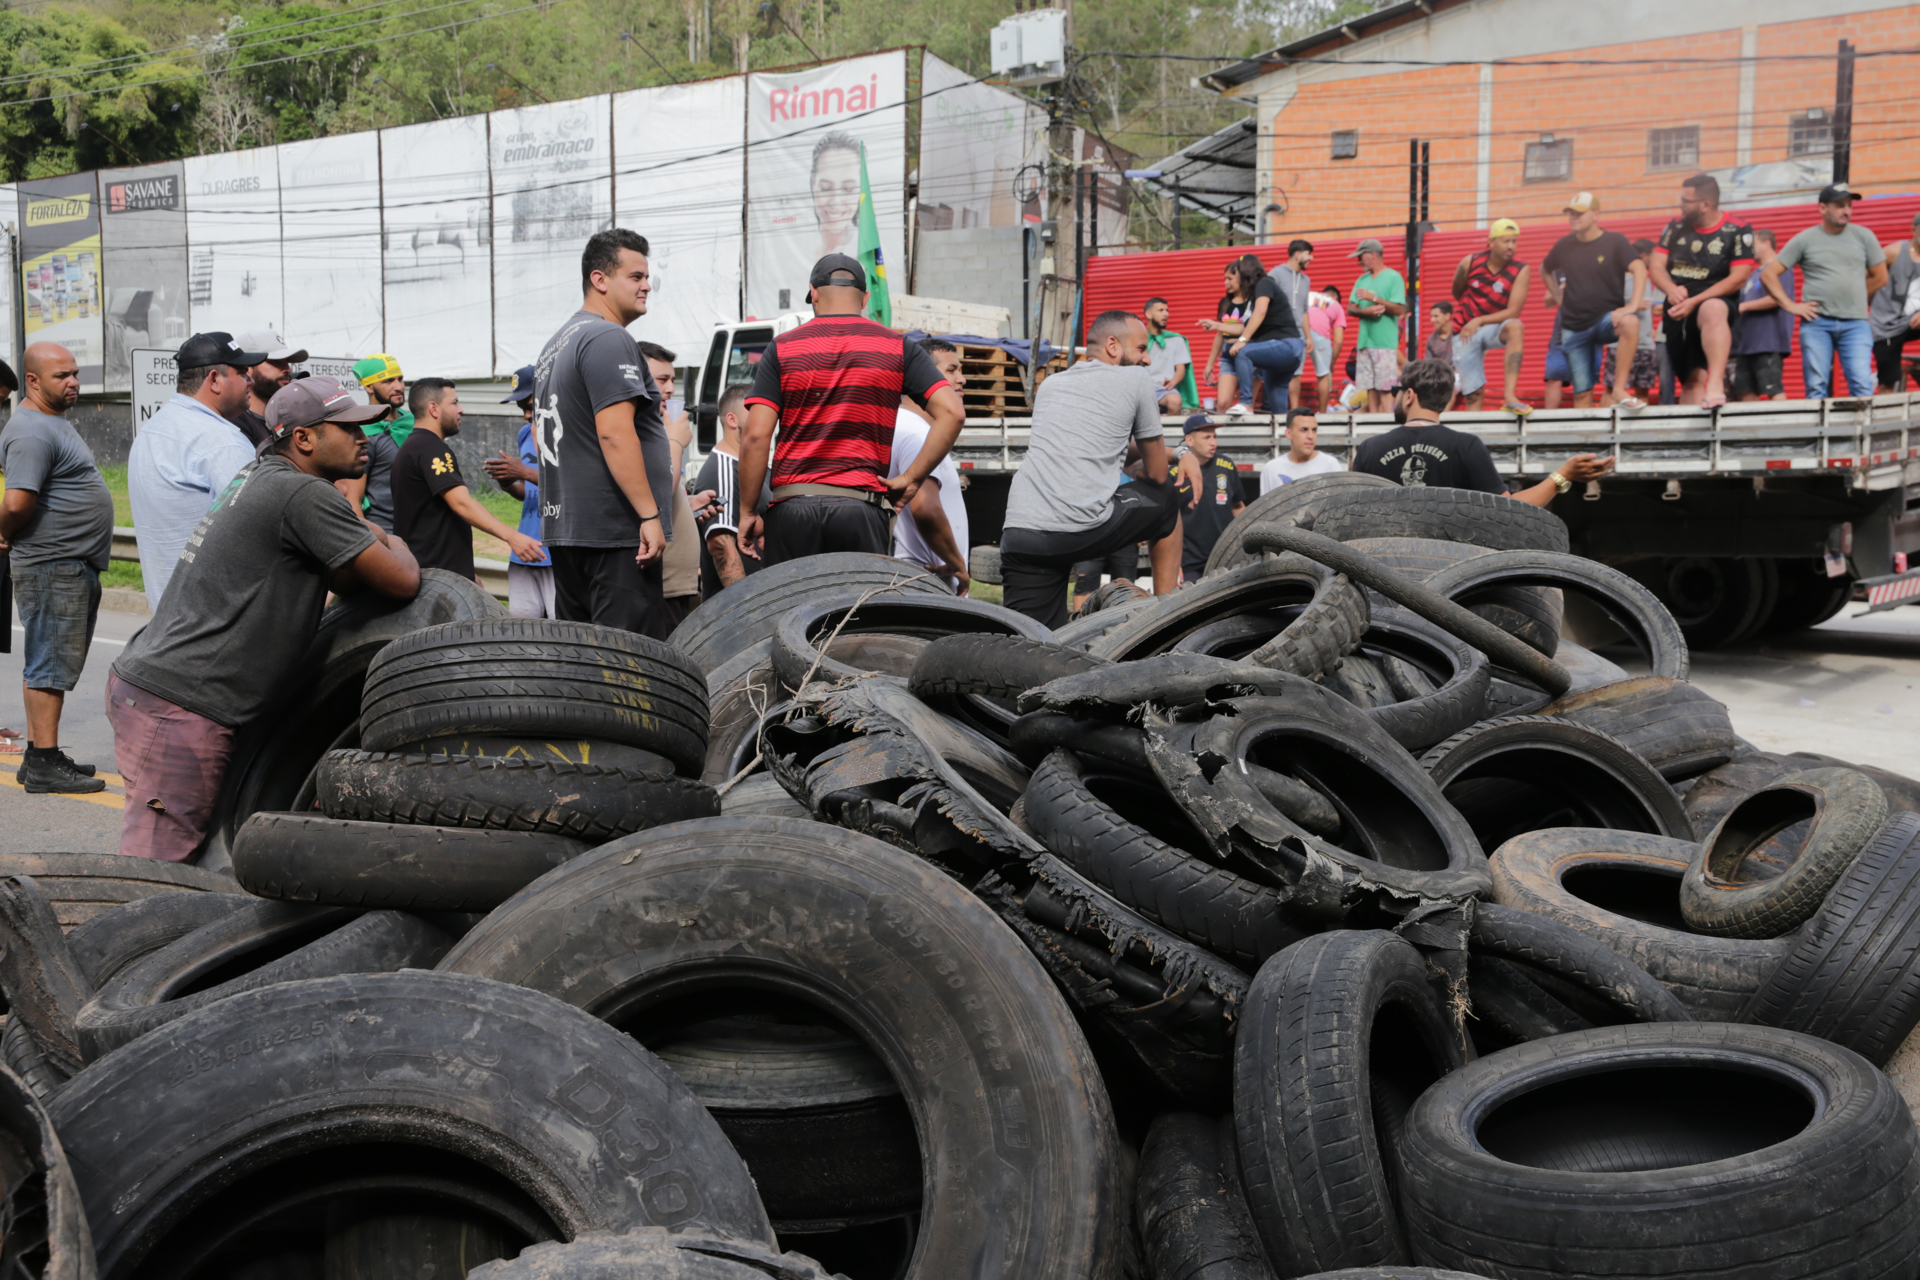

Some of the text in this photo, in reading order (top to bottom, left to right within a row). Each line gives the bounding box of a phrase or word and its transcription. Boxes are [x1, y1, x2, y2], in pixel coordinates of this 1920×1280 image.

[770, 74, 877, 122] Rinnai
[504, 137, 595, 162] embramaco
[125, 179, 172, 201] SAVANE
[202, 176, 260, 196] DURAGRES
[31, 200, 84, 221] FORTALEZA
[444, 452, 455, 473] vivo
[1380, 446, 1406, 466] PIZZA
[1579, 736, 1663, 793] PIRELLI
